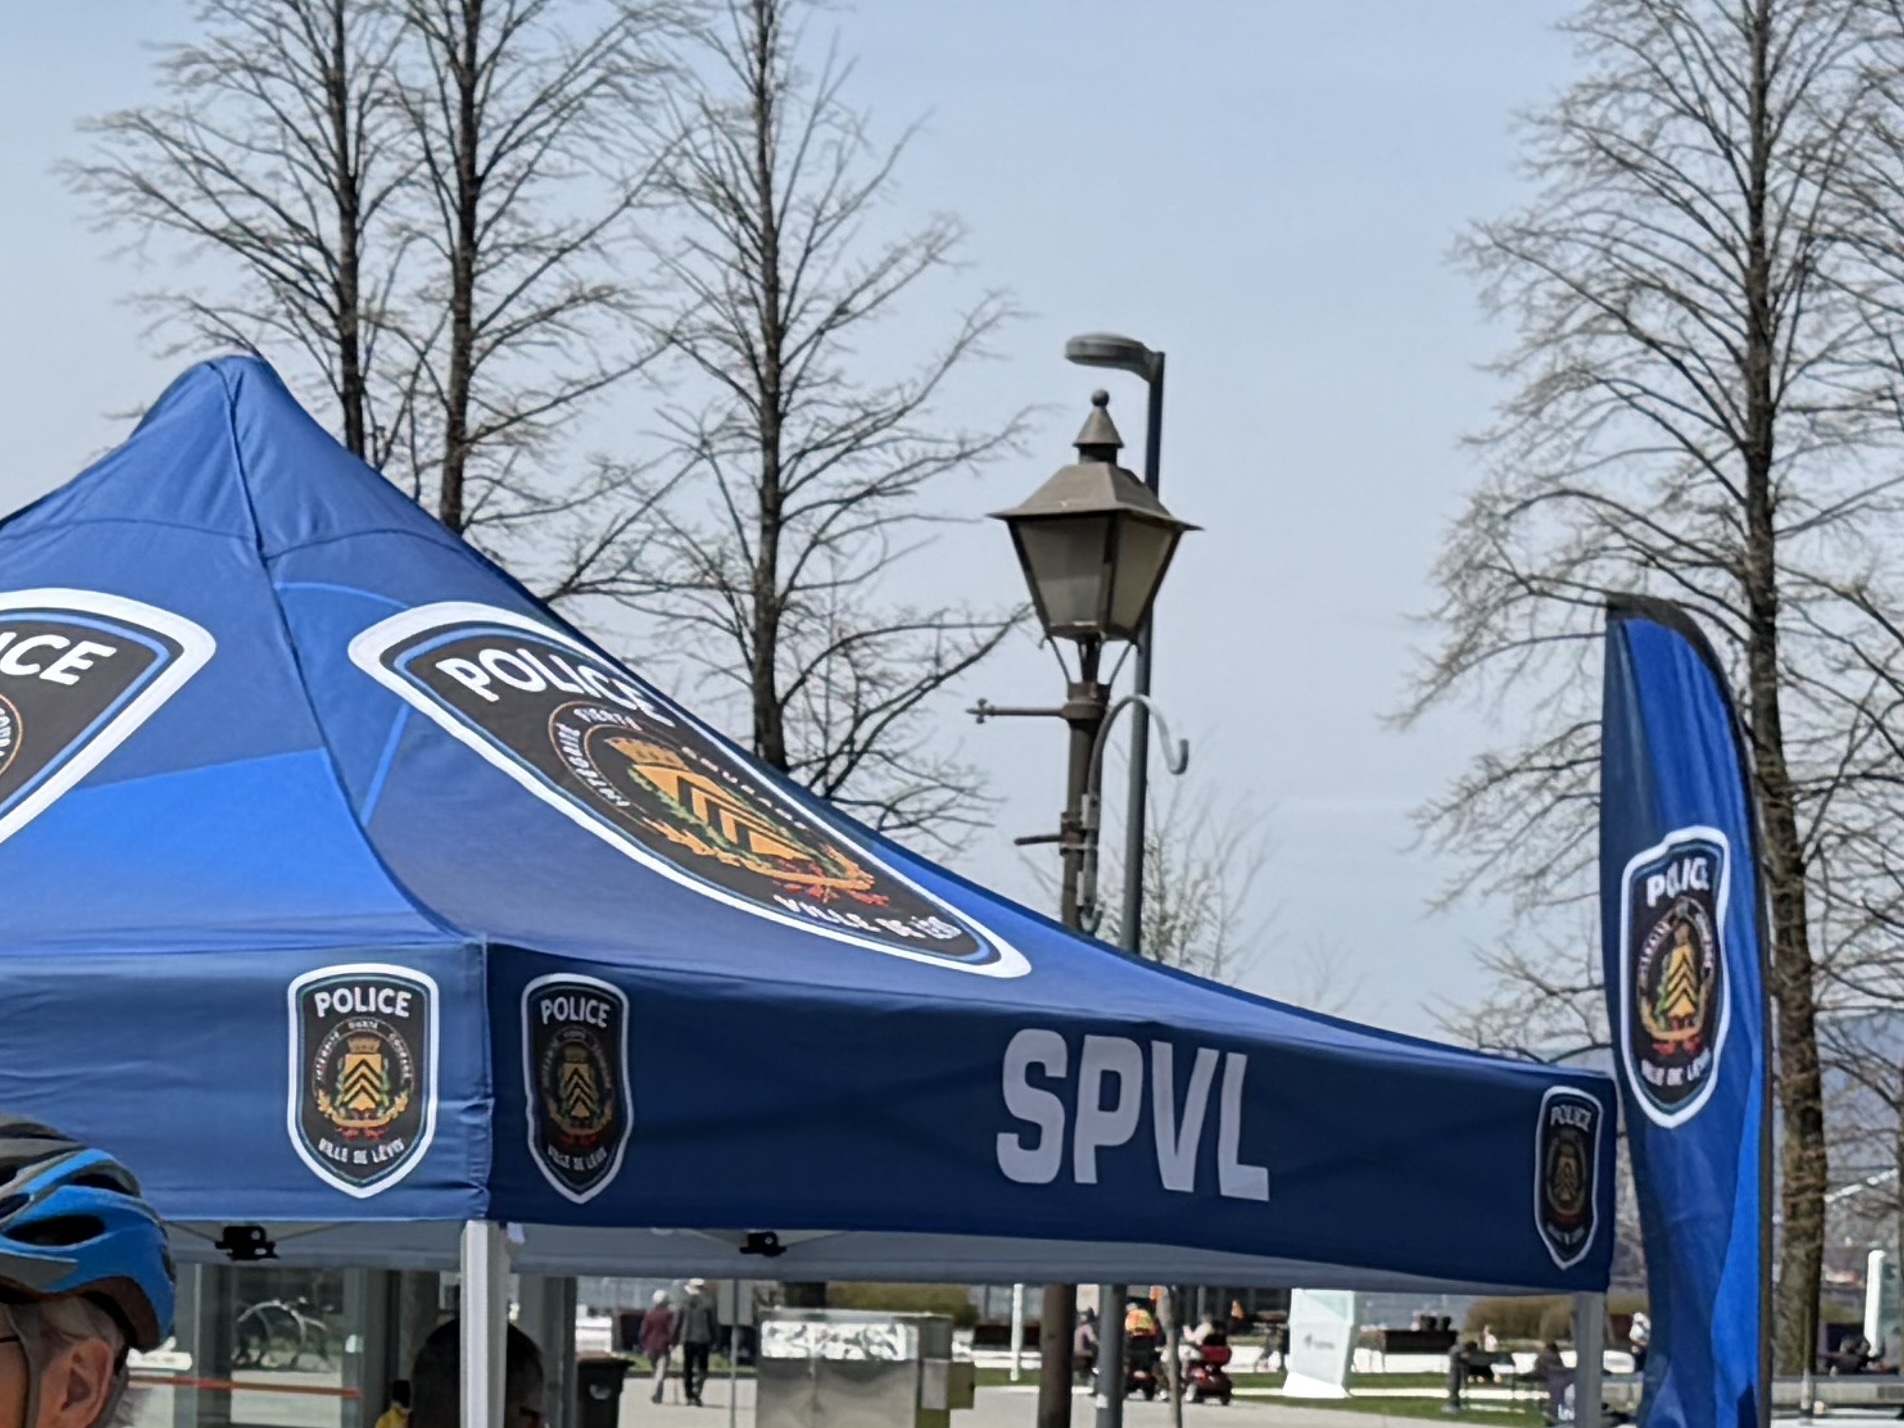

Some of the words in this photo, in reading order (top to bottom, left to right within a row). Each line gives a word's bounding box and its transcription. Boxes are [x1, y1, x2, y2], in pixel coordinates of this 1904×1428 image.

[434, 647, 676, 729] POLICE
[313, 987, 413, 1018] POLICE
[540, 996, 612, 1028] POLICE
[995, 1027, 1271, 1202] SPVL
